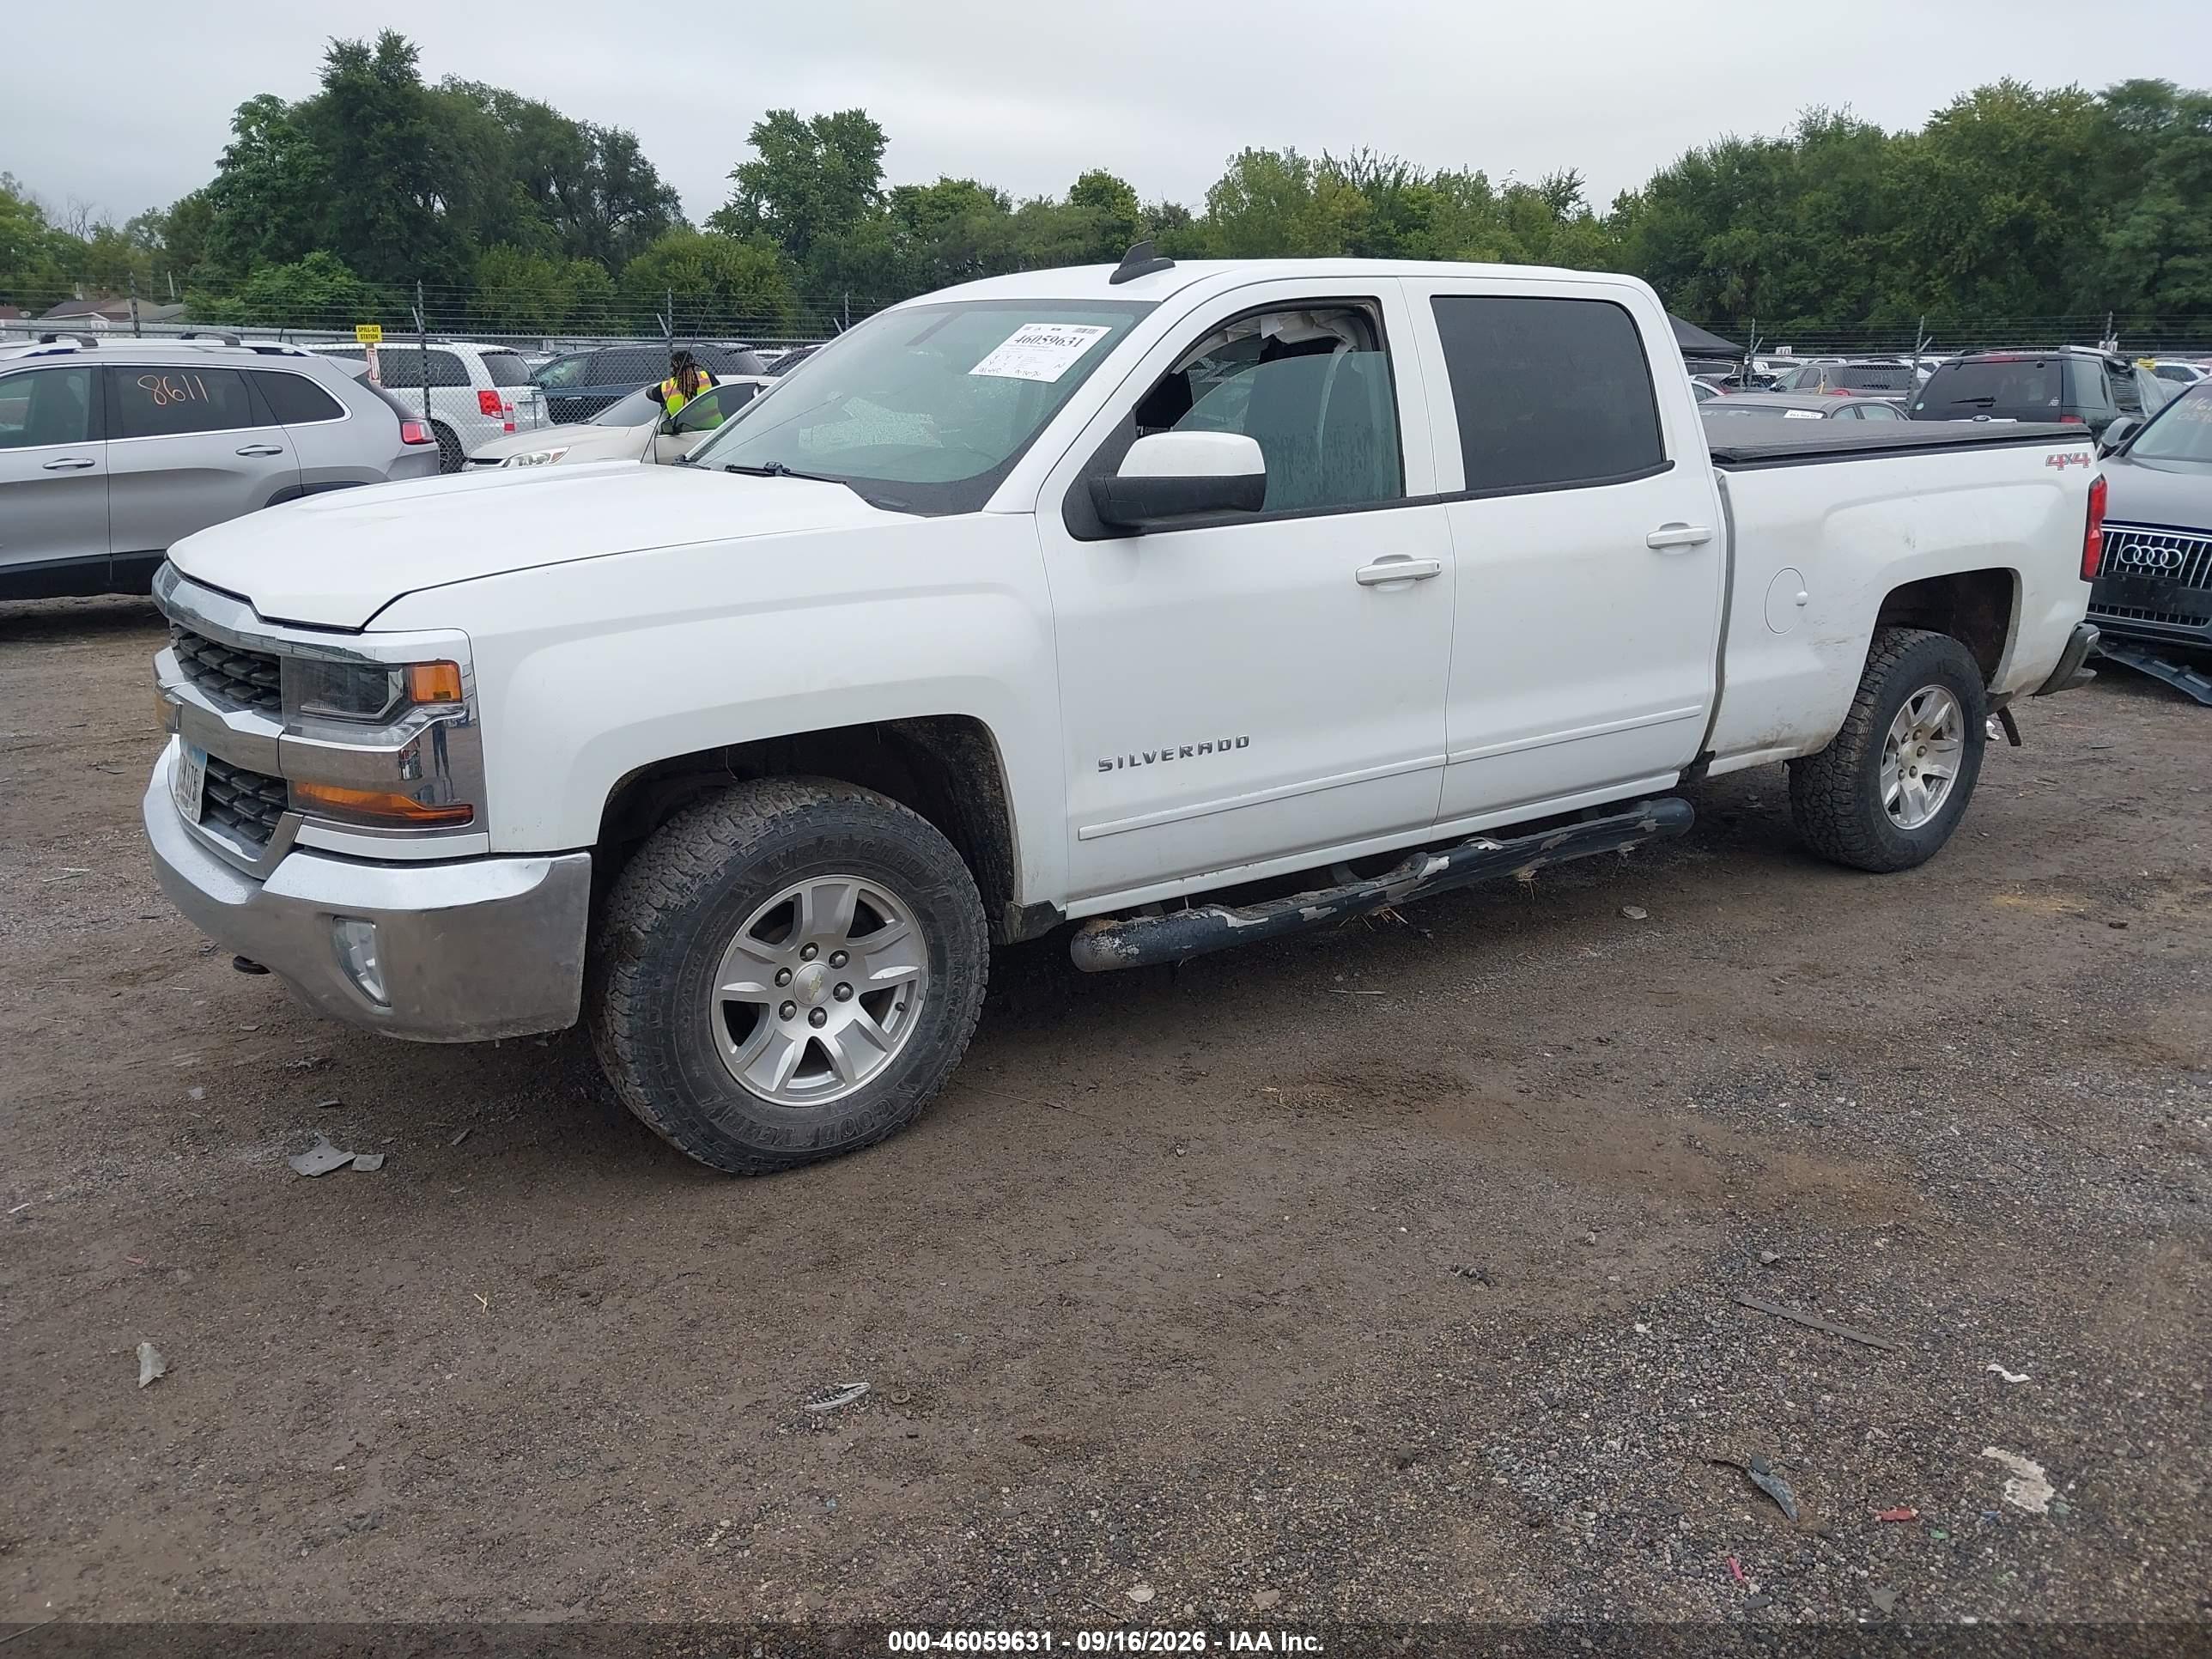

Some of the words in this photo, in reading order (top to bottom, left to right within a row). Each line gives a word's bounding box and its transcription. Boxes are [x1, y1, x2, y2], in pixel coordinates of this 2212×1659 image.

[1014, 334, 1085, 348] 46059631
[137, 374, 210, 405] 8611
[1097, 734, 1250, 773] SILVERADO
